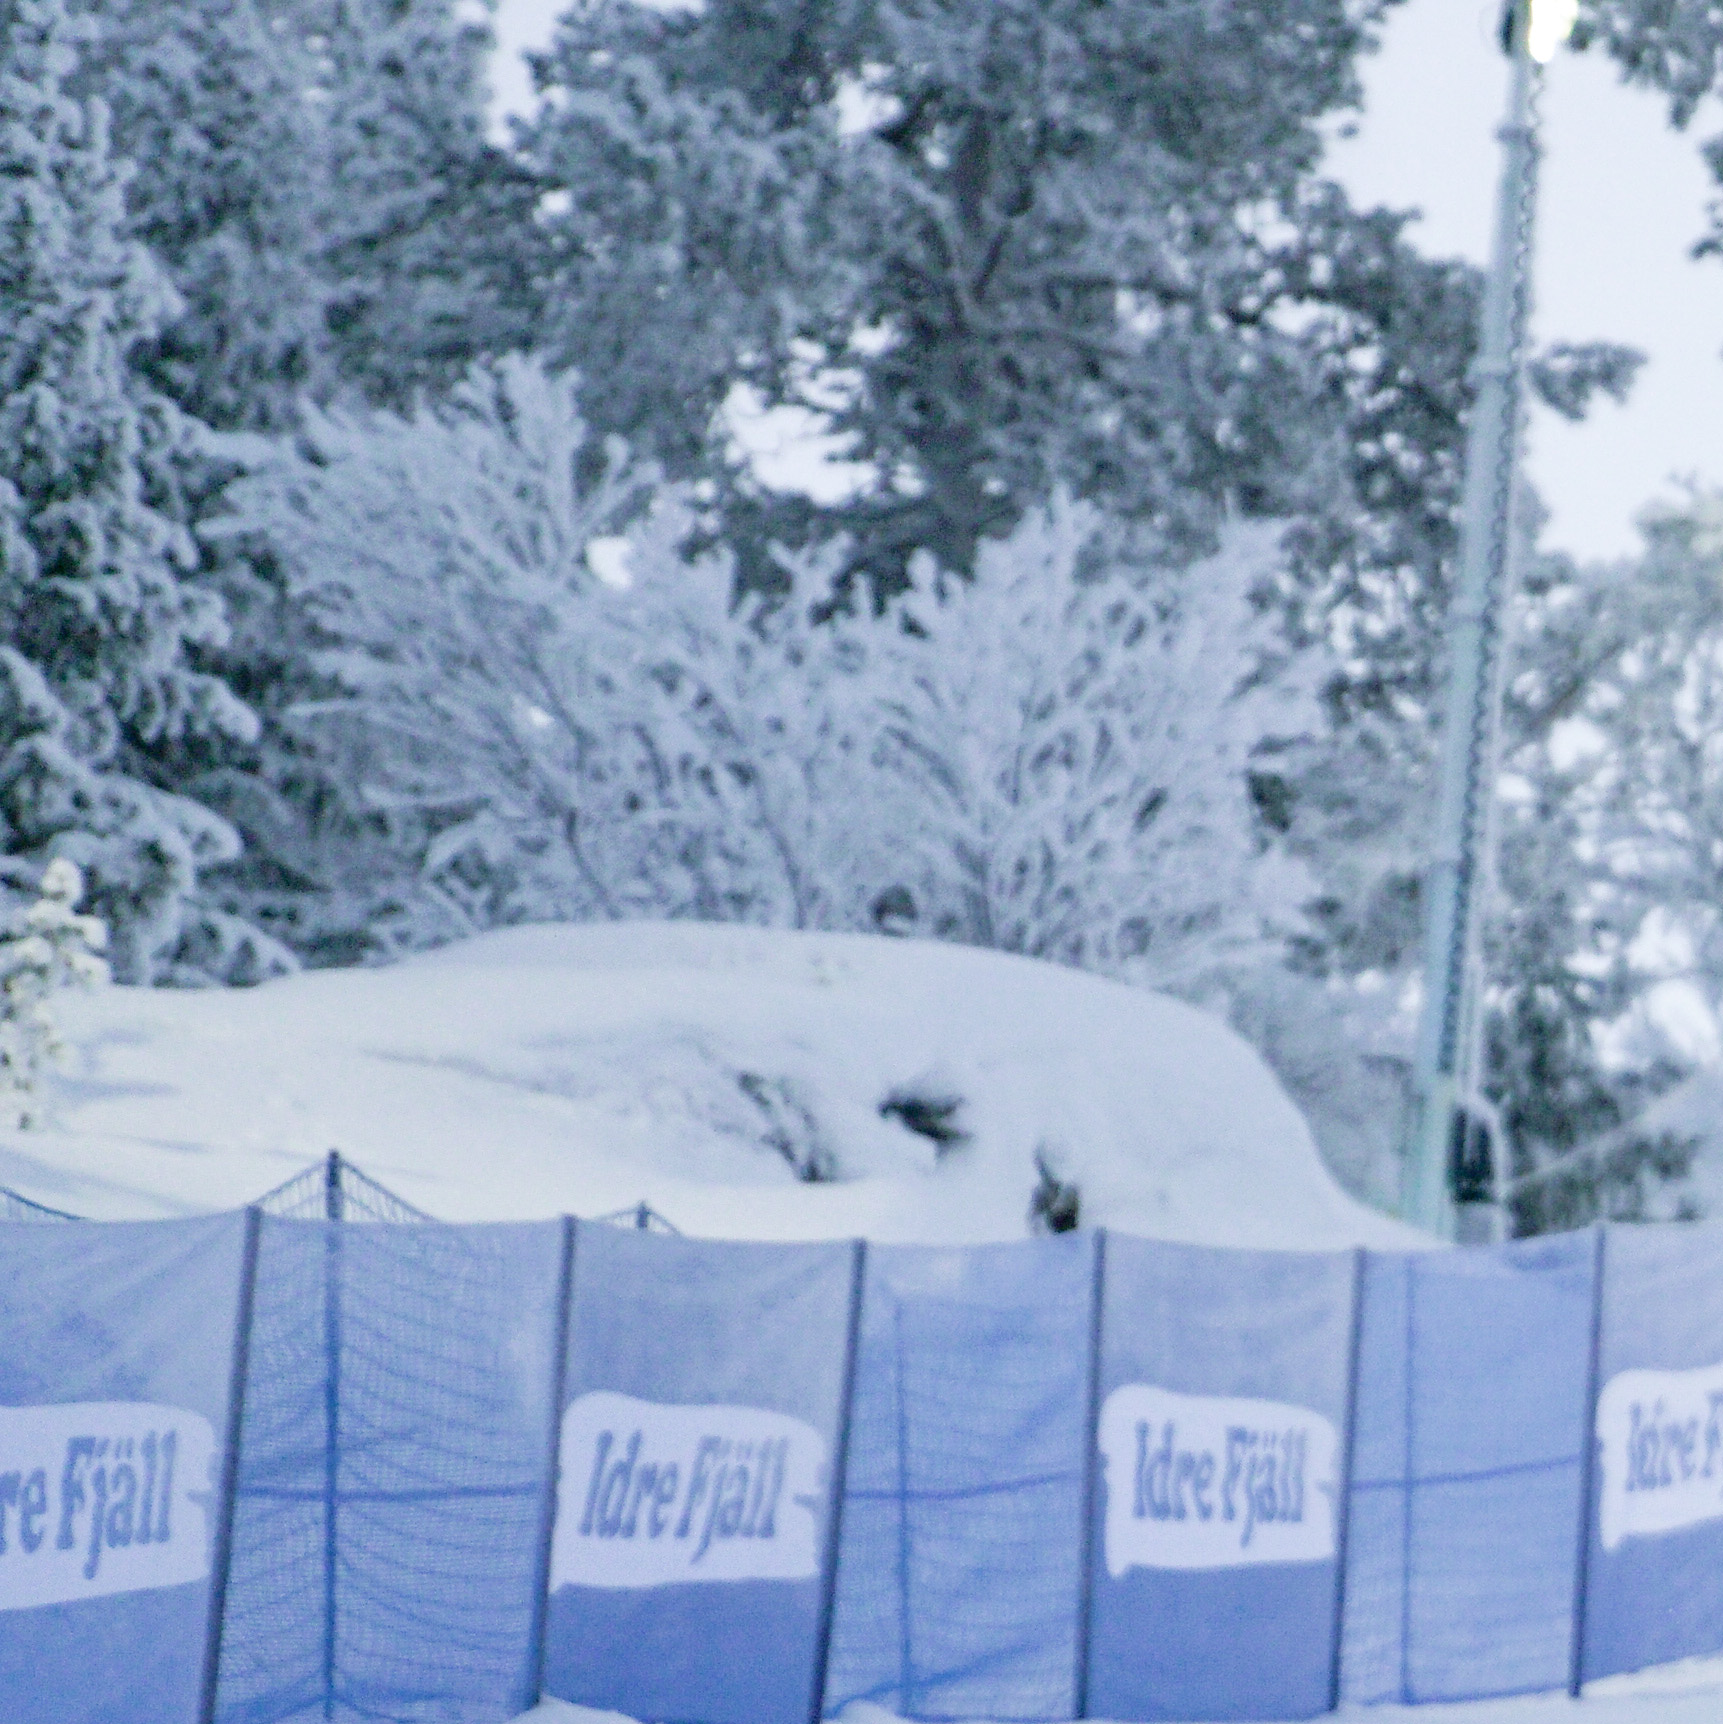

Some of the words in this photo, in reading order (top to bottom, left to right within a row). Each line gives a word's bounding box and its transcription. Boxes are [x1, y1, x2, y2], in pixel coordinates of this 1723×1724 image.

[56, 1428, 177, 1580] Fjäll
[578, 1429, 680, 1540] Idre
[673, 1434, 790, 1566] Fjäll
[1132, 1418, 1214, 1522] Idre
[1220, 1424, 1306, 1549] Fjäll
